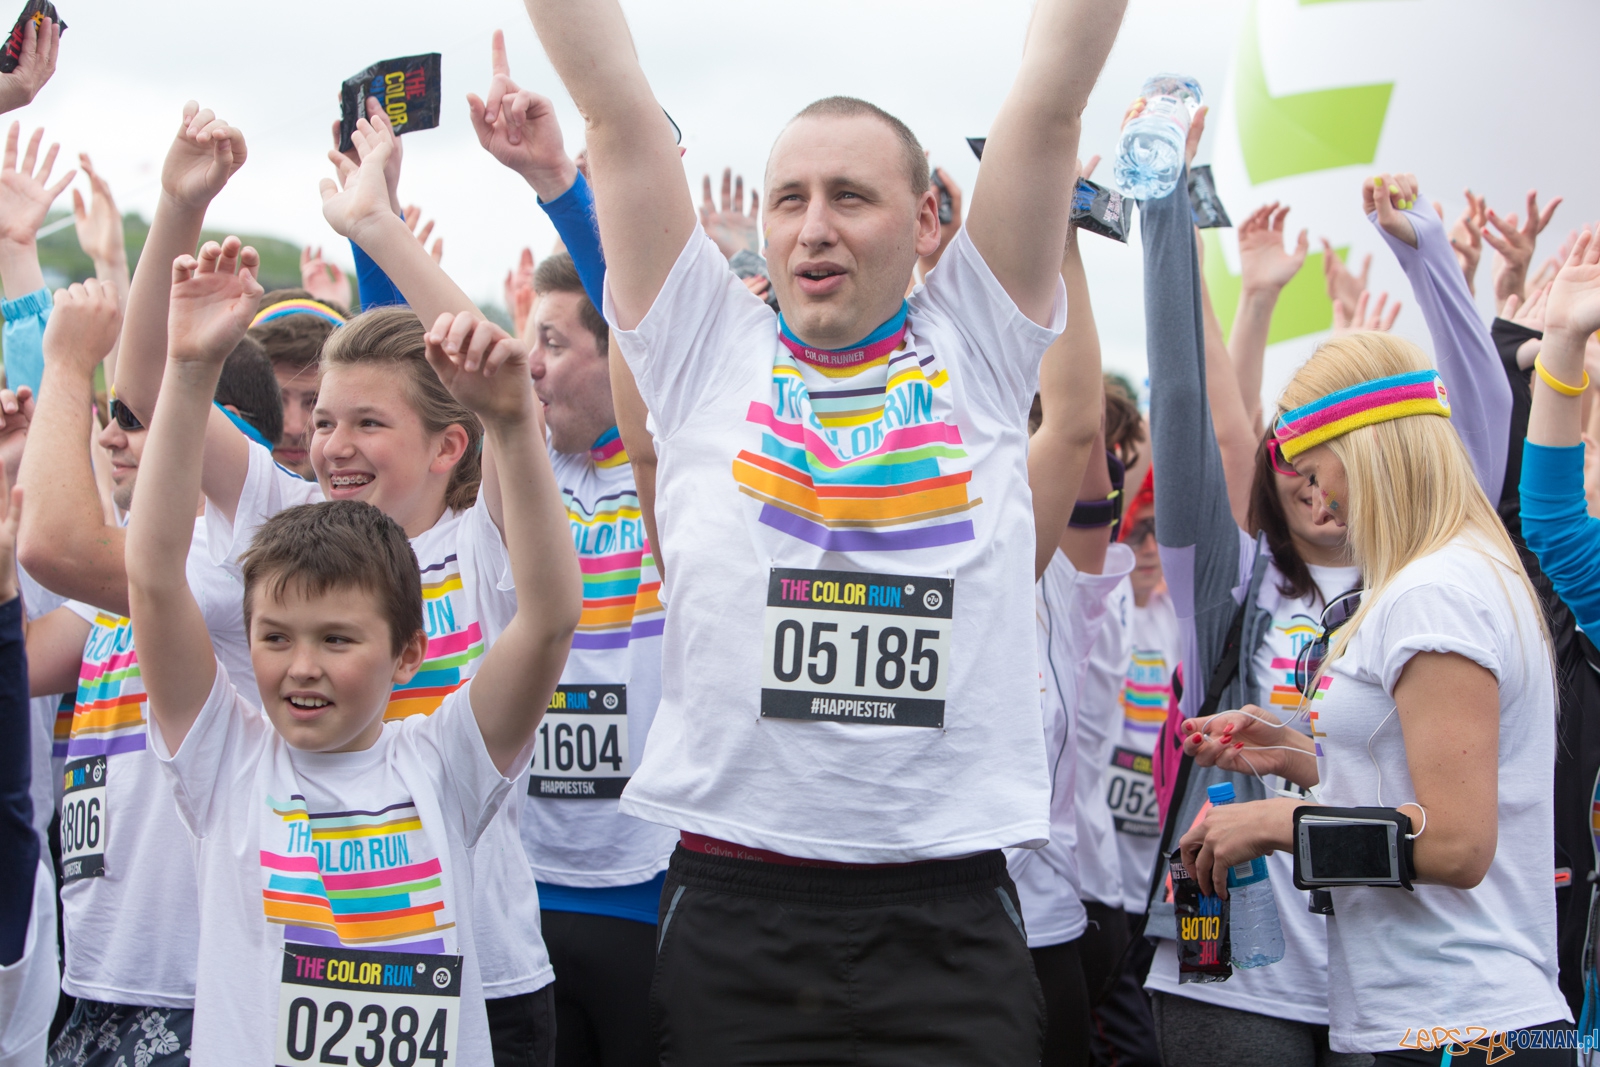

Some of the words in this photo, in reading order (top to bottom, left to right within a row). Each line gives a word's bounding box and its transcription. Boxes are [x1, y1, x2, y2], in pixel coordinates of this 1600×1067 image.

[384, 71, 408, 126] COLOR
[405, 66, 426, 100] THE
[883, 381, 933, 430] RUN
[620, 519, 644, 551] RU
[780, 579, 811, 602] THE
[811, 580, 866, 606] COLOR
[868, 584, 901, 609] RUN
[422, 595, 456, 638] UN
[773, 619, 940, 692] 05185
[567, 692, 588, 709] RUN
[810, 697, 897, 719] #HAPPIEST5K
[531, 723, 623, 771] 1604
[540, 780, 596, 795] #HAPPIEST5K
[1108, 776, 1158, 819] 052
[287, 822, 311, 853] TH
[368, 834, 410, 870] RUN
[704, 842, 734, 859] Calvin
[1181, 916, 1221, 941] COLOR
[1198, 942, 1220, 965] THE
[295, 955, 326, 980] THE
[326, 959, 382, 986] COLOR
[383, 964, 414, 988] RUN
[286, 997, 449, 1067] 02384
